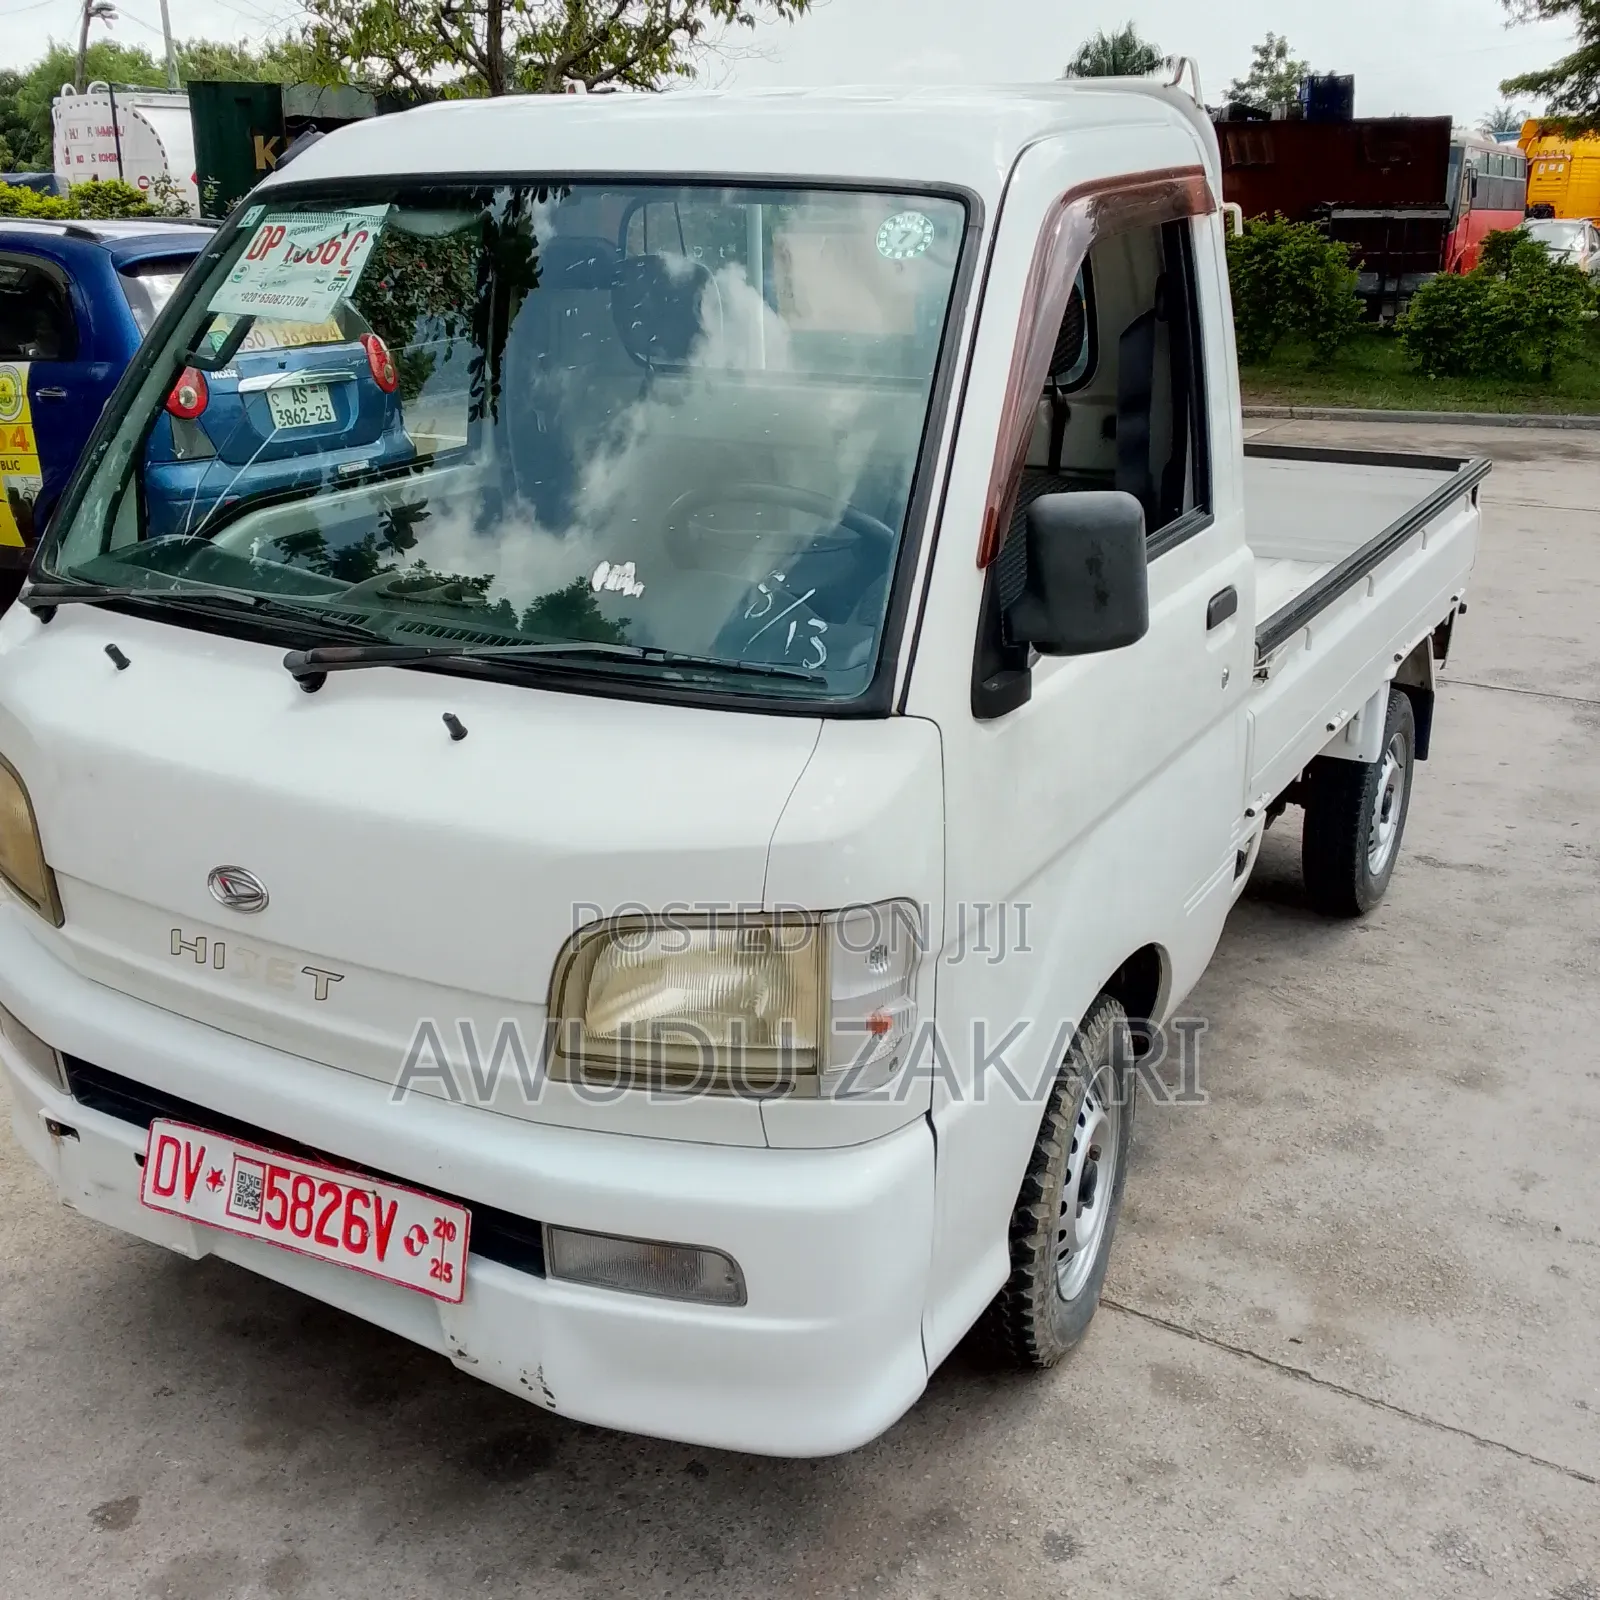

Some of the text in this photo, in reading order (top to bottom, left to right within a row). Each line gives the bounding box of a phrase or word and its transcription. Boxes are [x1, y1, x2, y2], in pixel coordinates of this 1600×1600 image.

[245, 225, 287, 261] DP
[898, 230, 912, 245] 7
[291, 386, 308, 406] AS
[276, 404, 332, 427] 3862-23
[152, 1134, 399, 1263] DV 5826V
